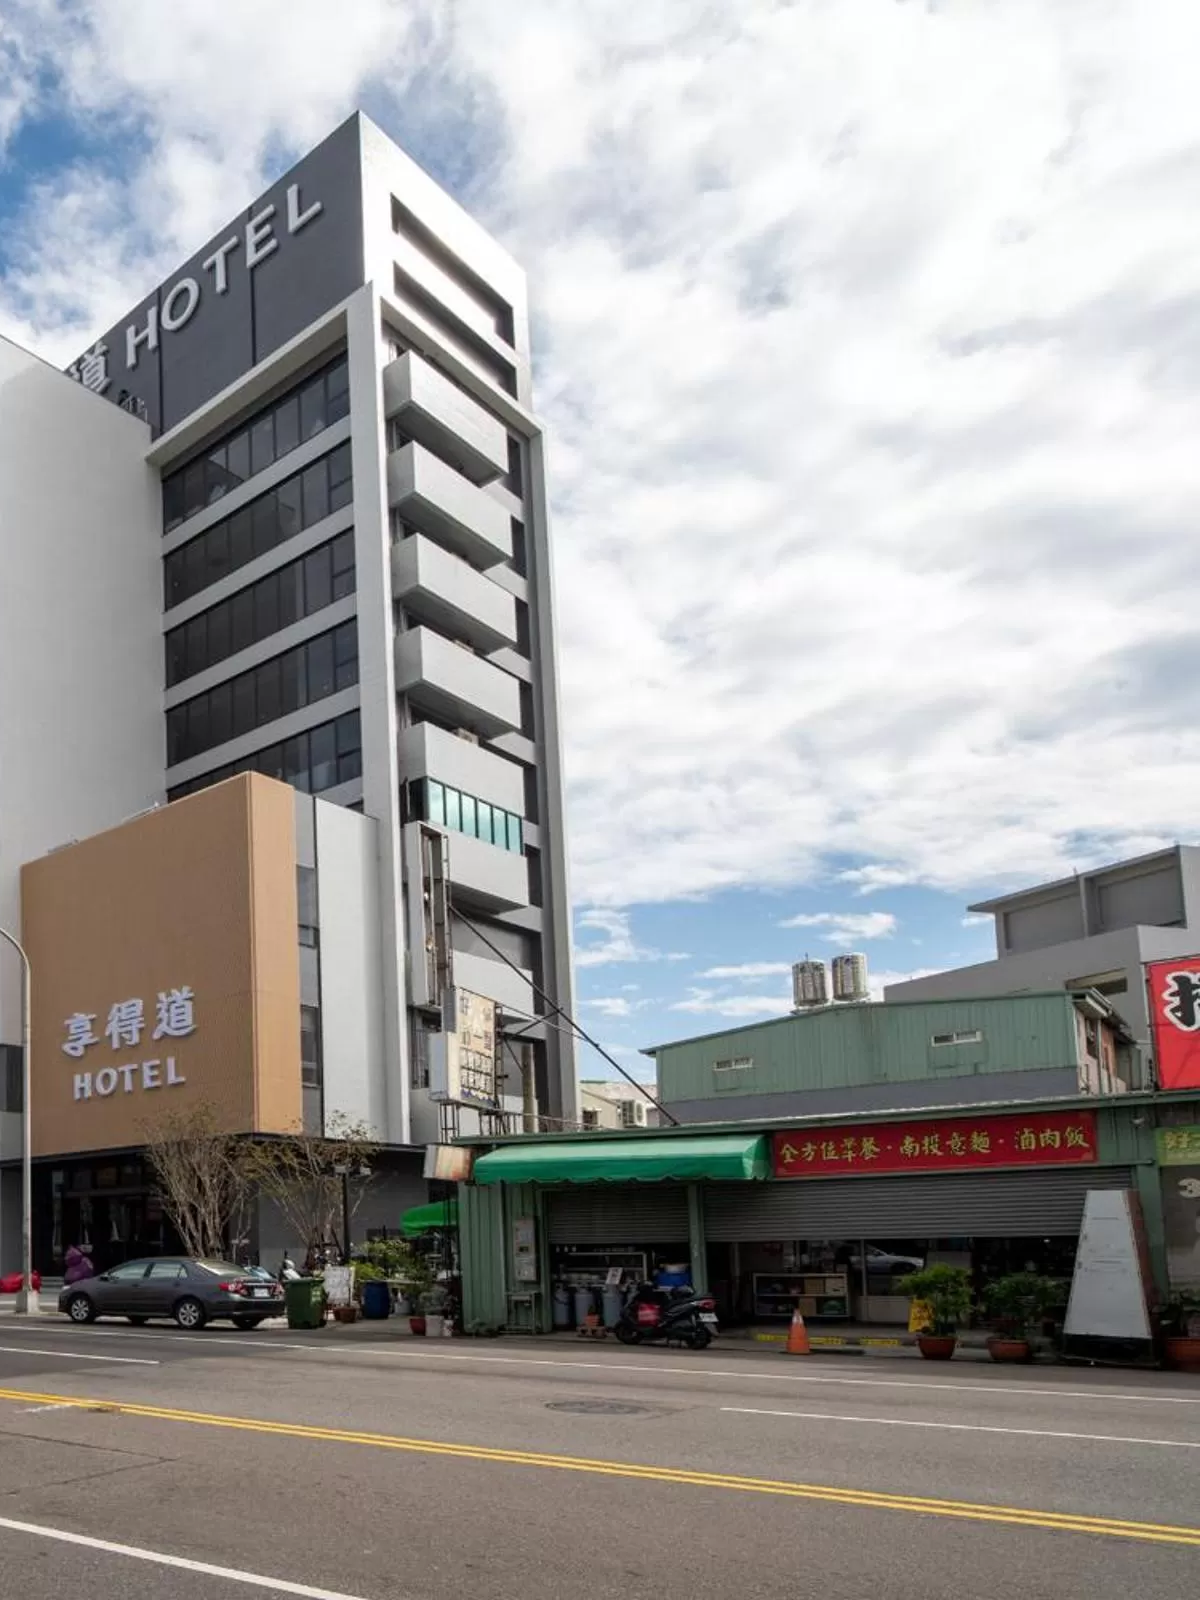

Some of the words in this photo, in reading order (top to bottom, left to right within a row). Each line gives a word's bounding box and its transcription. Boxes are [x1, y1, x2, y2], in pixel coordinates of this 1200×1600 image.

[126, 184, 323, 369] HOTEL
[62, 985, 197, 1057] 享得道
[73, 1056, 186, 1100] HOTEL
[780, 1136, 880, 1163] 全方位早餐
